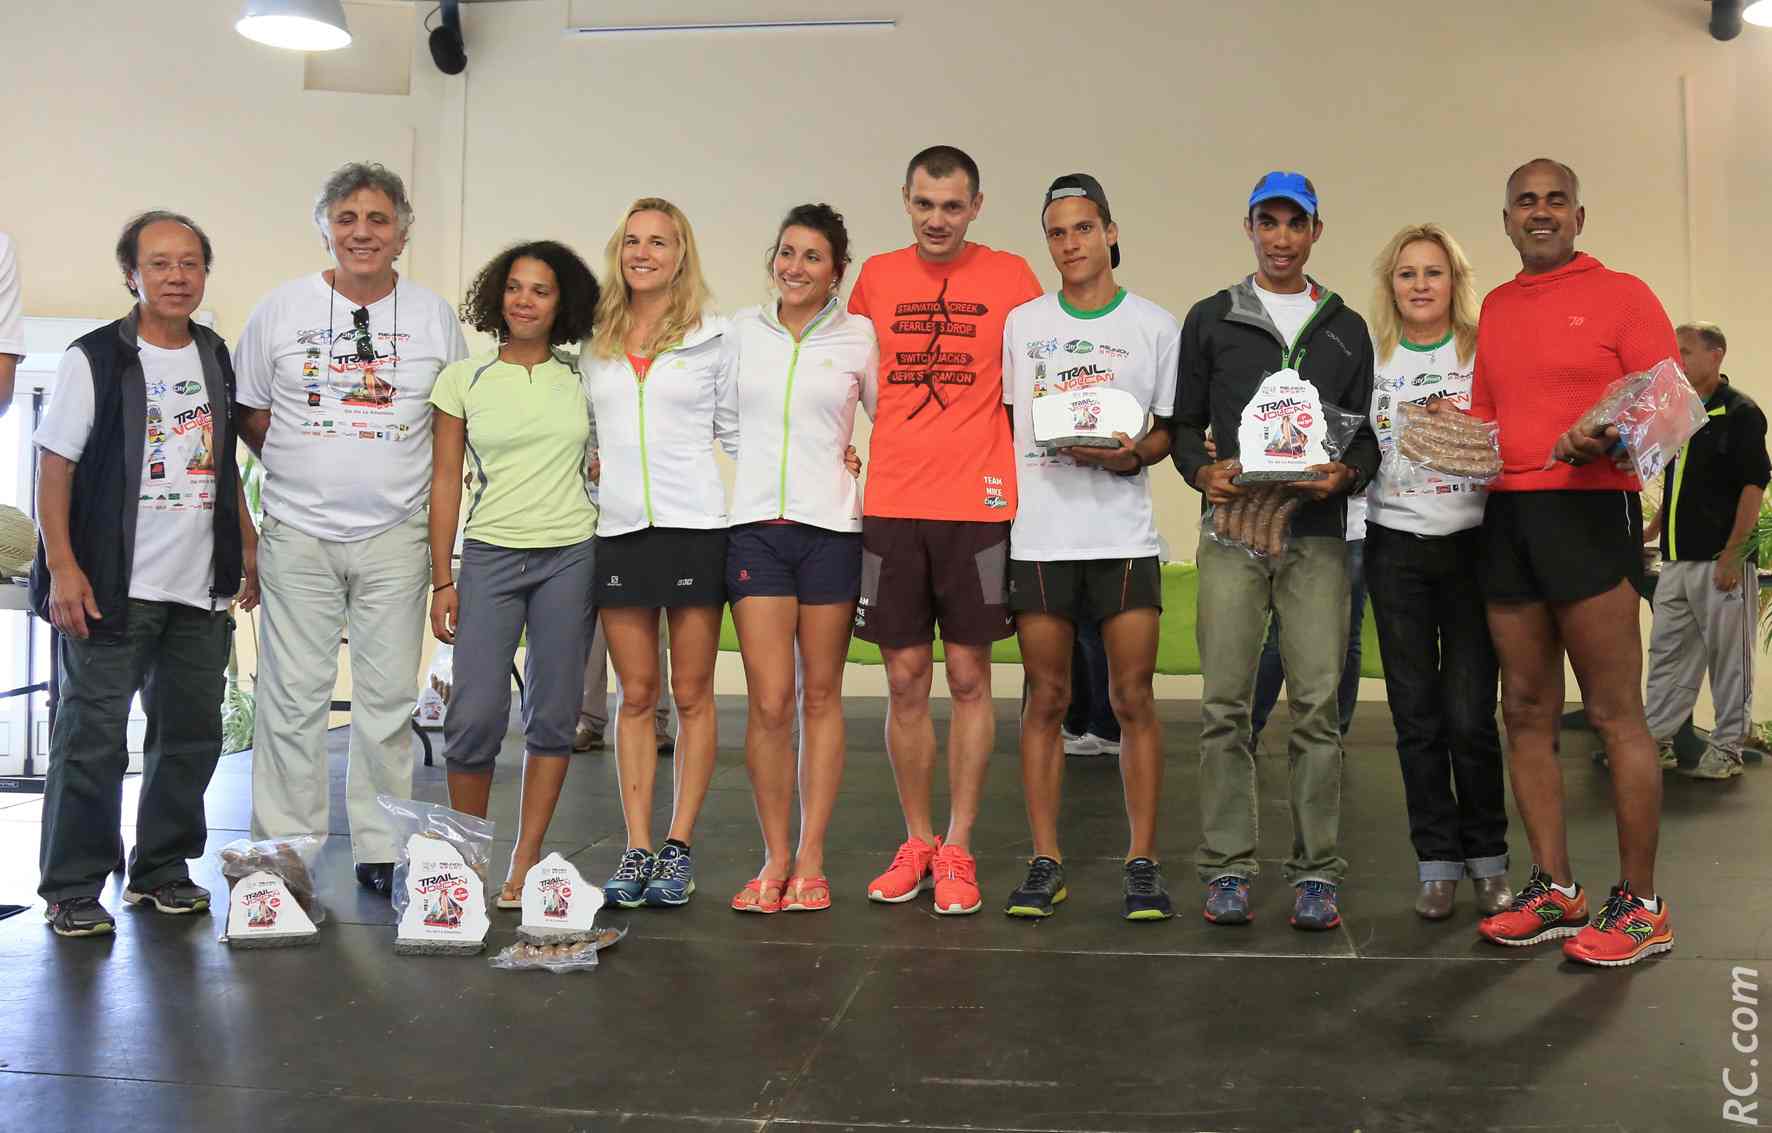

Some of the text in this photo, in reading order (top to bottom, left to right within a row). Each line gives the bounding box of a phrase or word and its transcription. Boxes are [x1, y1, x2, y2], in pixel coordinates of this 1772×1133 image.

[897, 303, 977, 313] STARVATIO CREEK
[899, 321, 973, 334] FEARLES DROP
[1057, 364, 1106, 382] TRAIL
[1257, 398, 1301, 413] TRAIL
[984, 476, 1003, 485] TEAM
[418, 873, 458, 887] TRAIL
